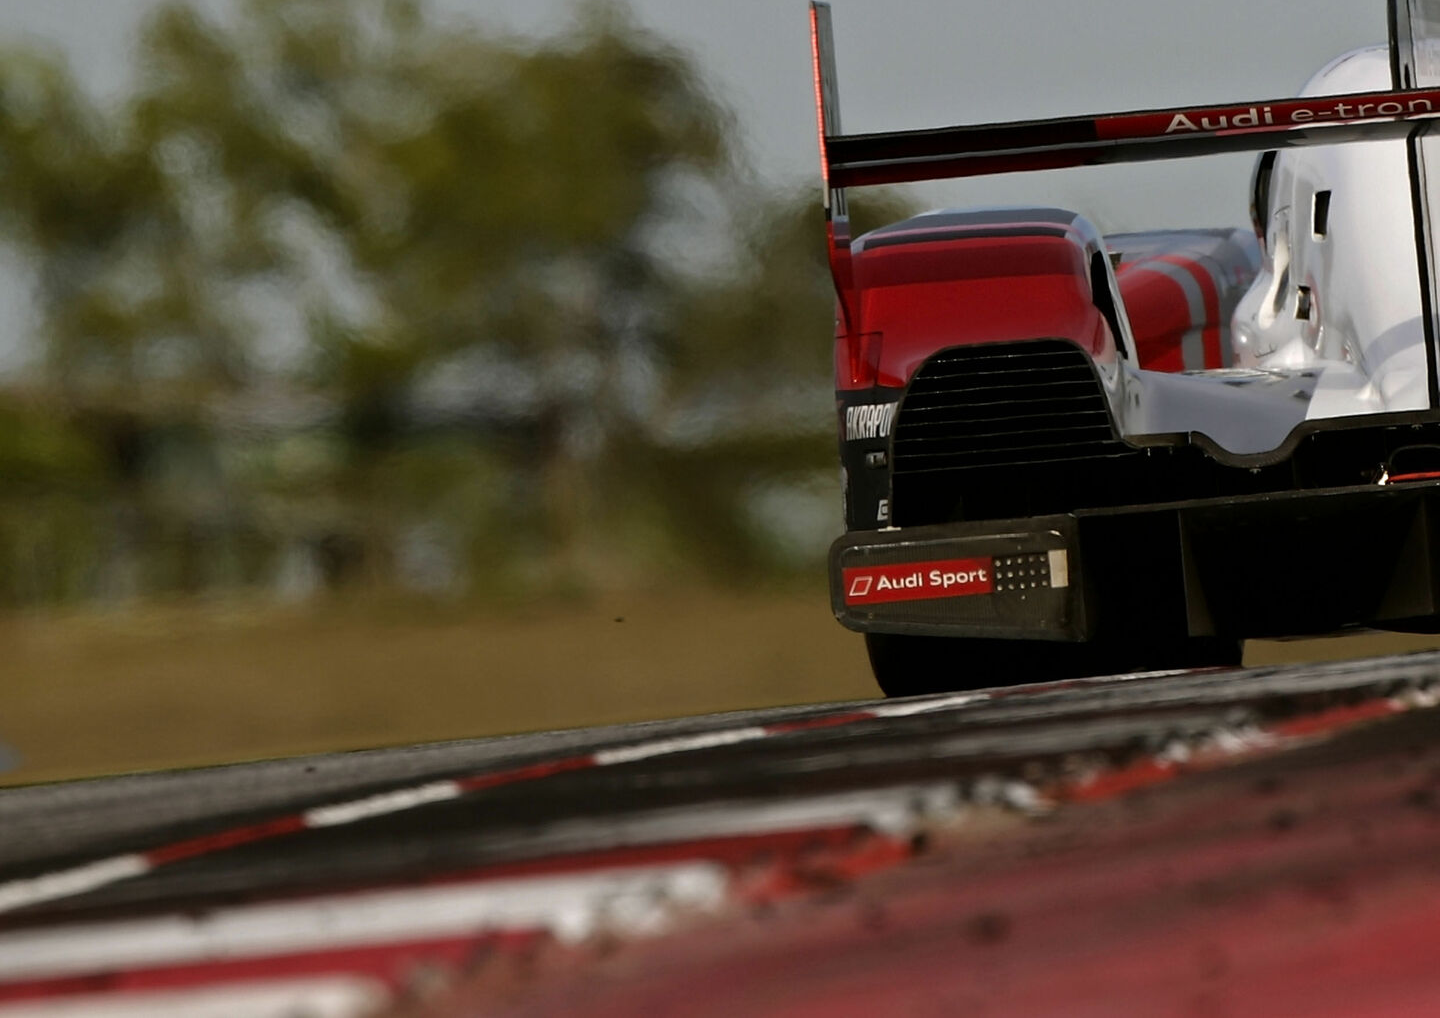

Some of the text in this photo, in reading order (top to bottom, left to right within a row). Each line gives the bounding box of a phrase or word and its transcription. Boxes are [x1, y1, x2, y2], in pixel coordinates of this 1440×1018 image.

[1165, 106, 1274, 133] Audi
[1291, 98, 1432, 123] e-tron
[876, 568, 987, 591] Audi Sport
